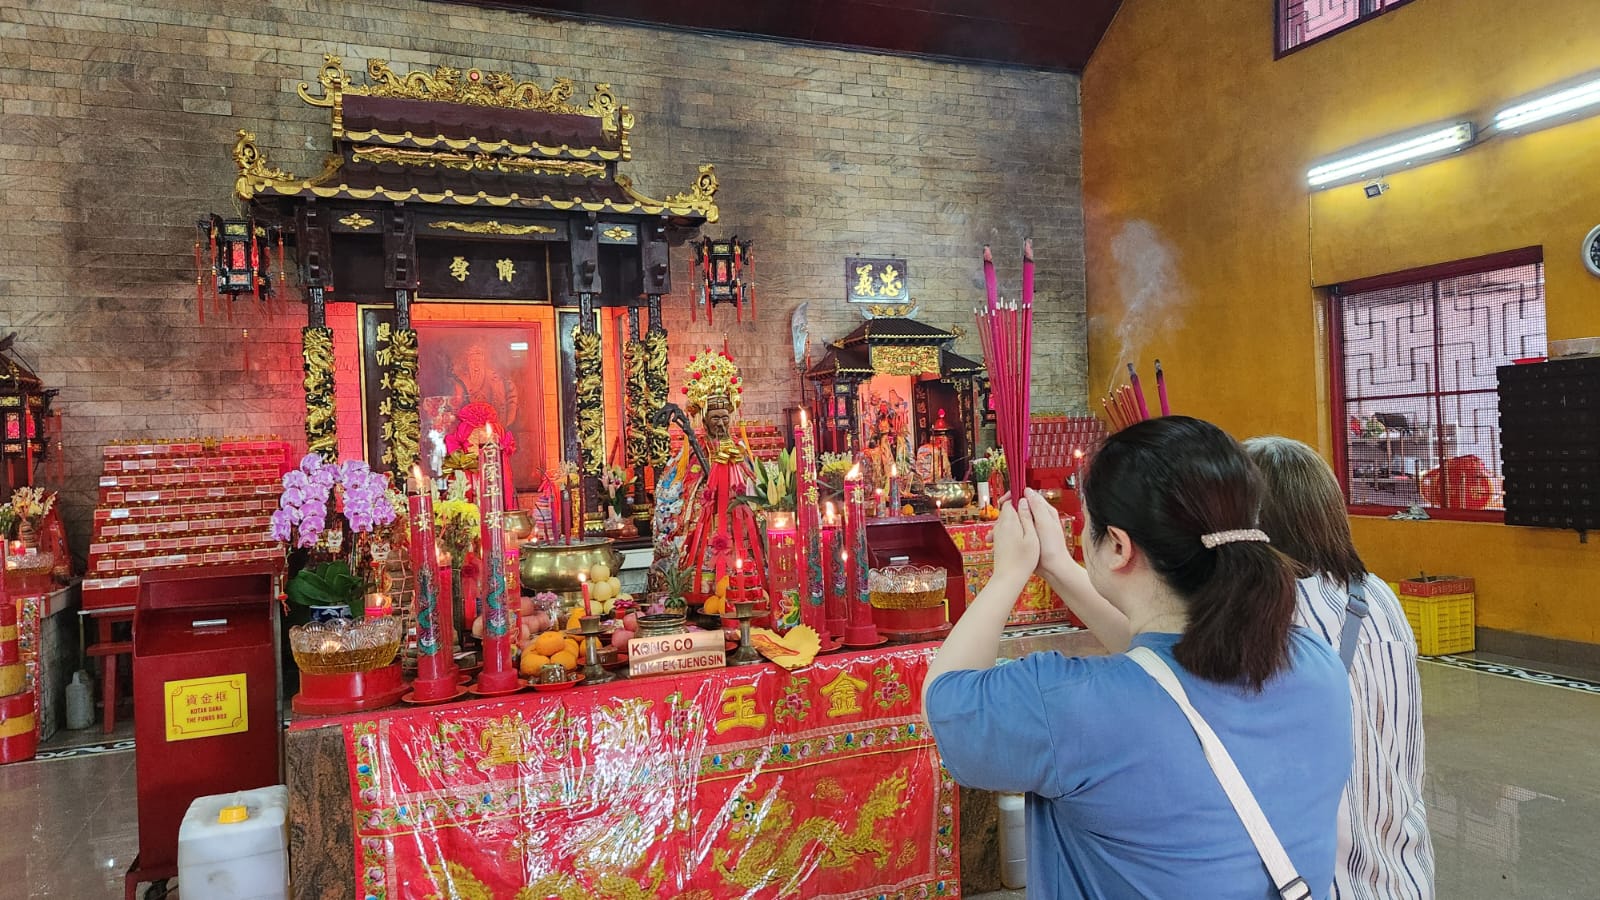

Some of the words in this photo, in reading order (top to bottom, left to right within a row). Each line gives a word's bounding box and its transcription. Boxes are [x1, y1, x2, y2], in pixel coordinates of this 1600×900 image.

[631, 641, 670, 657] KONG
[674, 638, 693, 652] CO
[677, 656, 706, 669] TJENG
[708, 654, 723, 666] SIN
